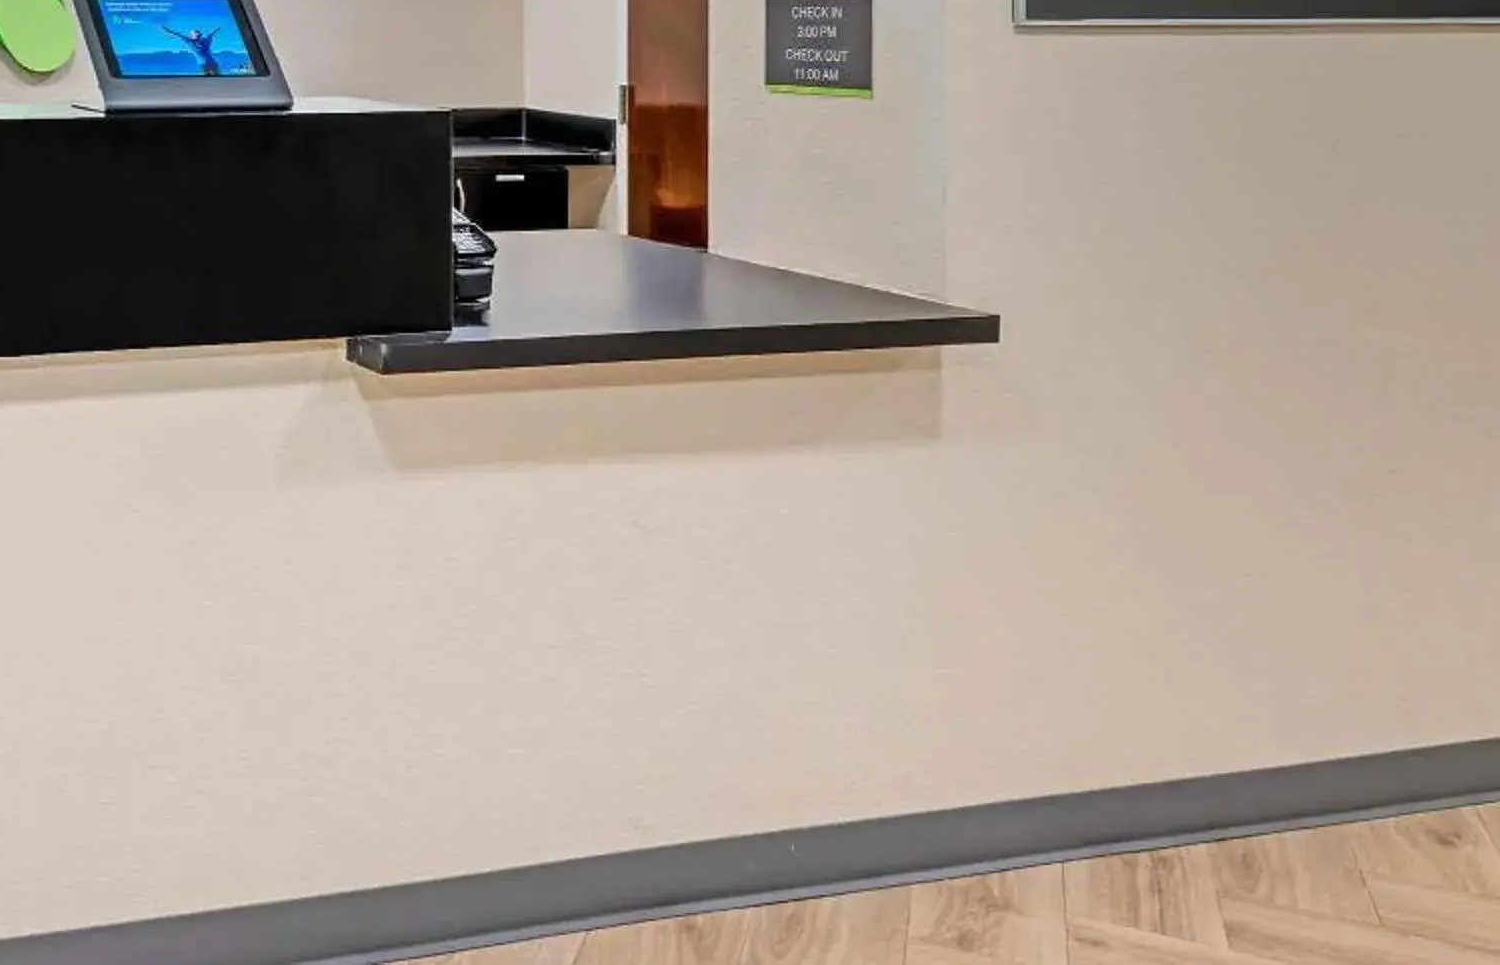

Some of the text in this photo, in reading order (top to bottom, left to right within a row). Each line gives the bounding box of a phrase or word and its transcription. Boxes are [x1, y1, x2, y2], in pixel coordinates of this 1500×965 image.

[791, 6, 843, 19] CHECK IN
[797, 25, 837, 38] 3:00 PM
[785, 48, 849, 62] CHECK OUT
[795, 68, 839, 81] 11:00 AM
